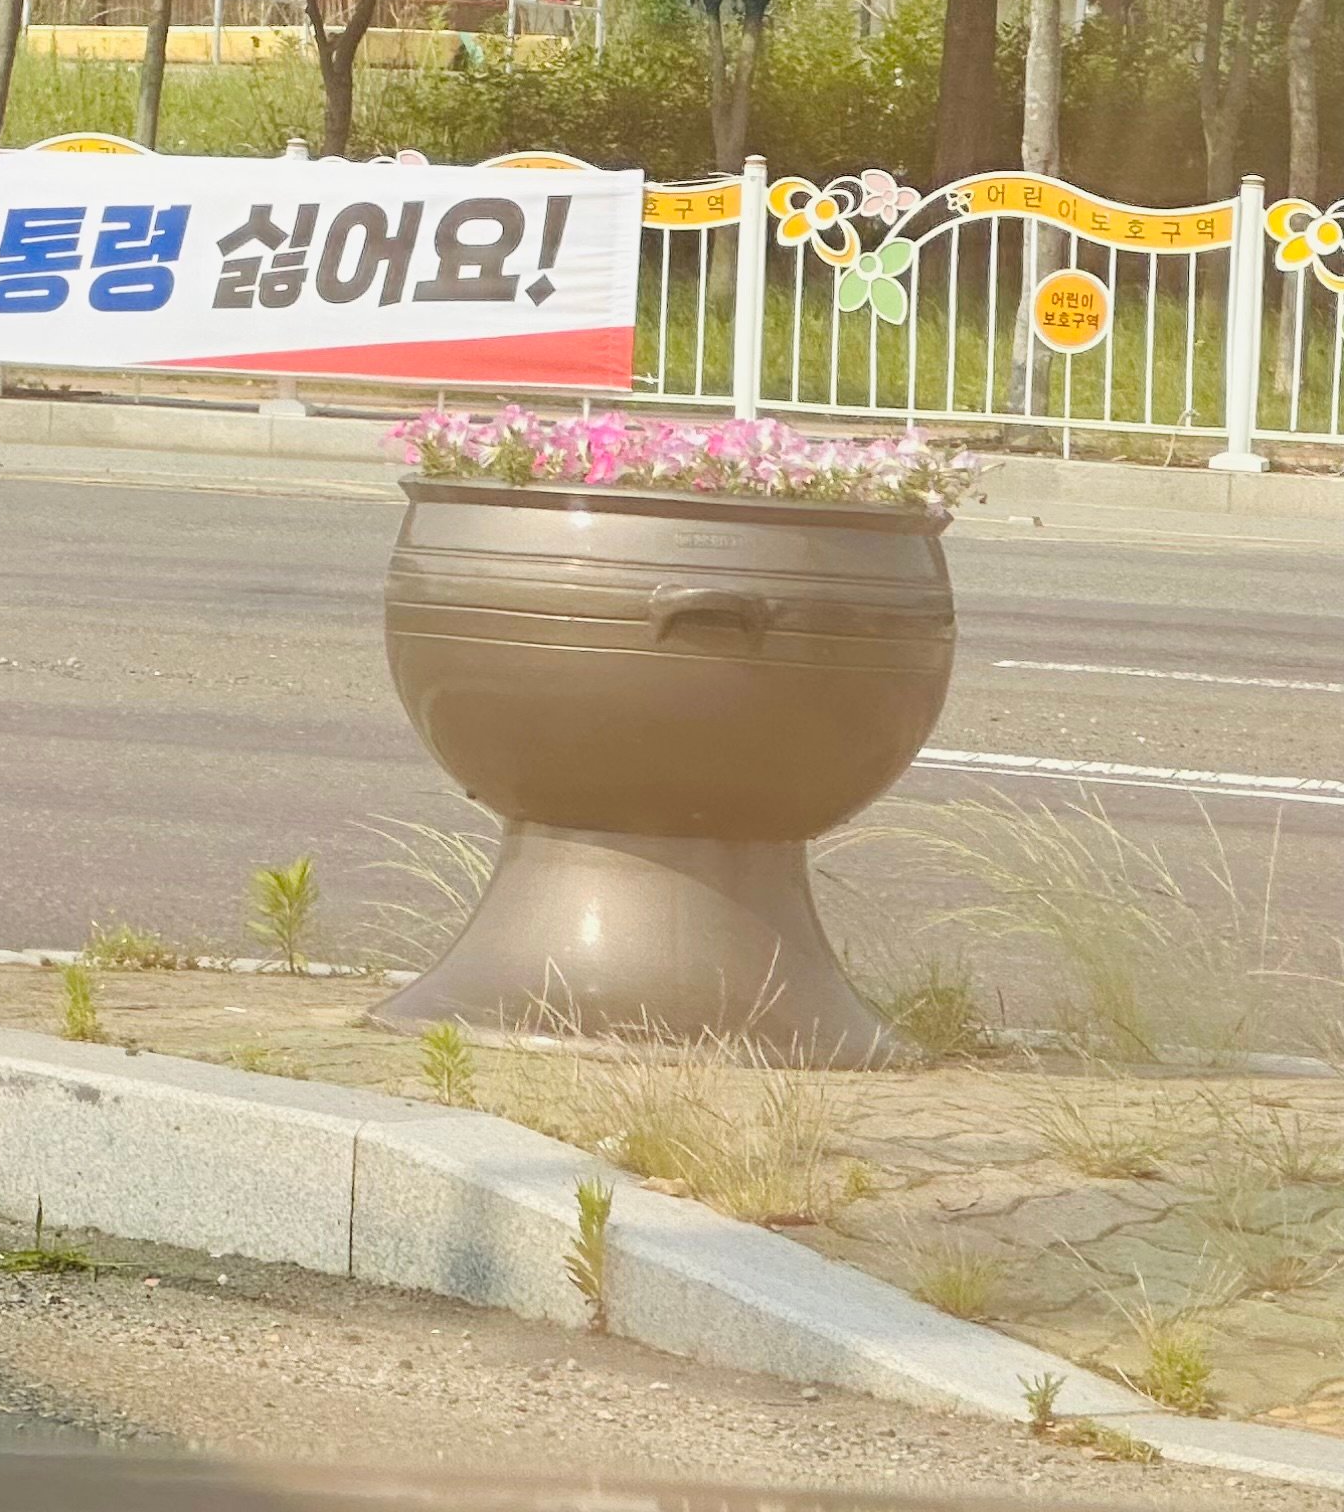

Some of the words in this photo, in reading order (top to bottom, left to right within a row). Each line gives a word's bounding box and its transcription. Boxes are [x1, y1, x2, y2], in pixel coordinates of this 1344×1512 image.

[212, 195, 573, 308] 싫어요!
[1051, 292, 1094, 310] 어린이
[1043, 311, 1100, 330] 보호구역
